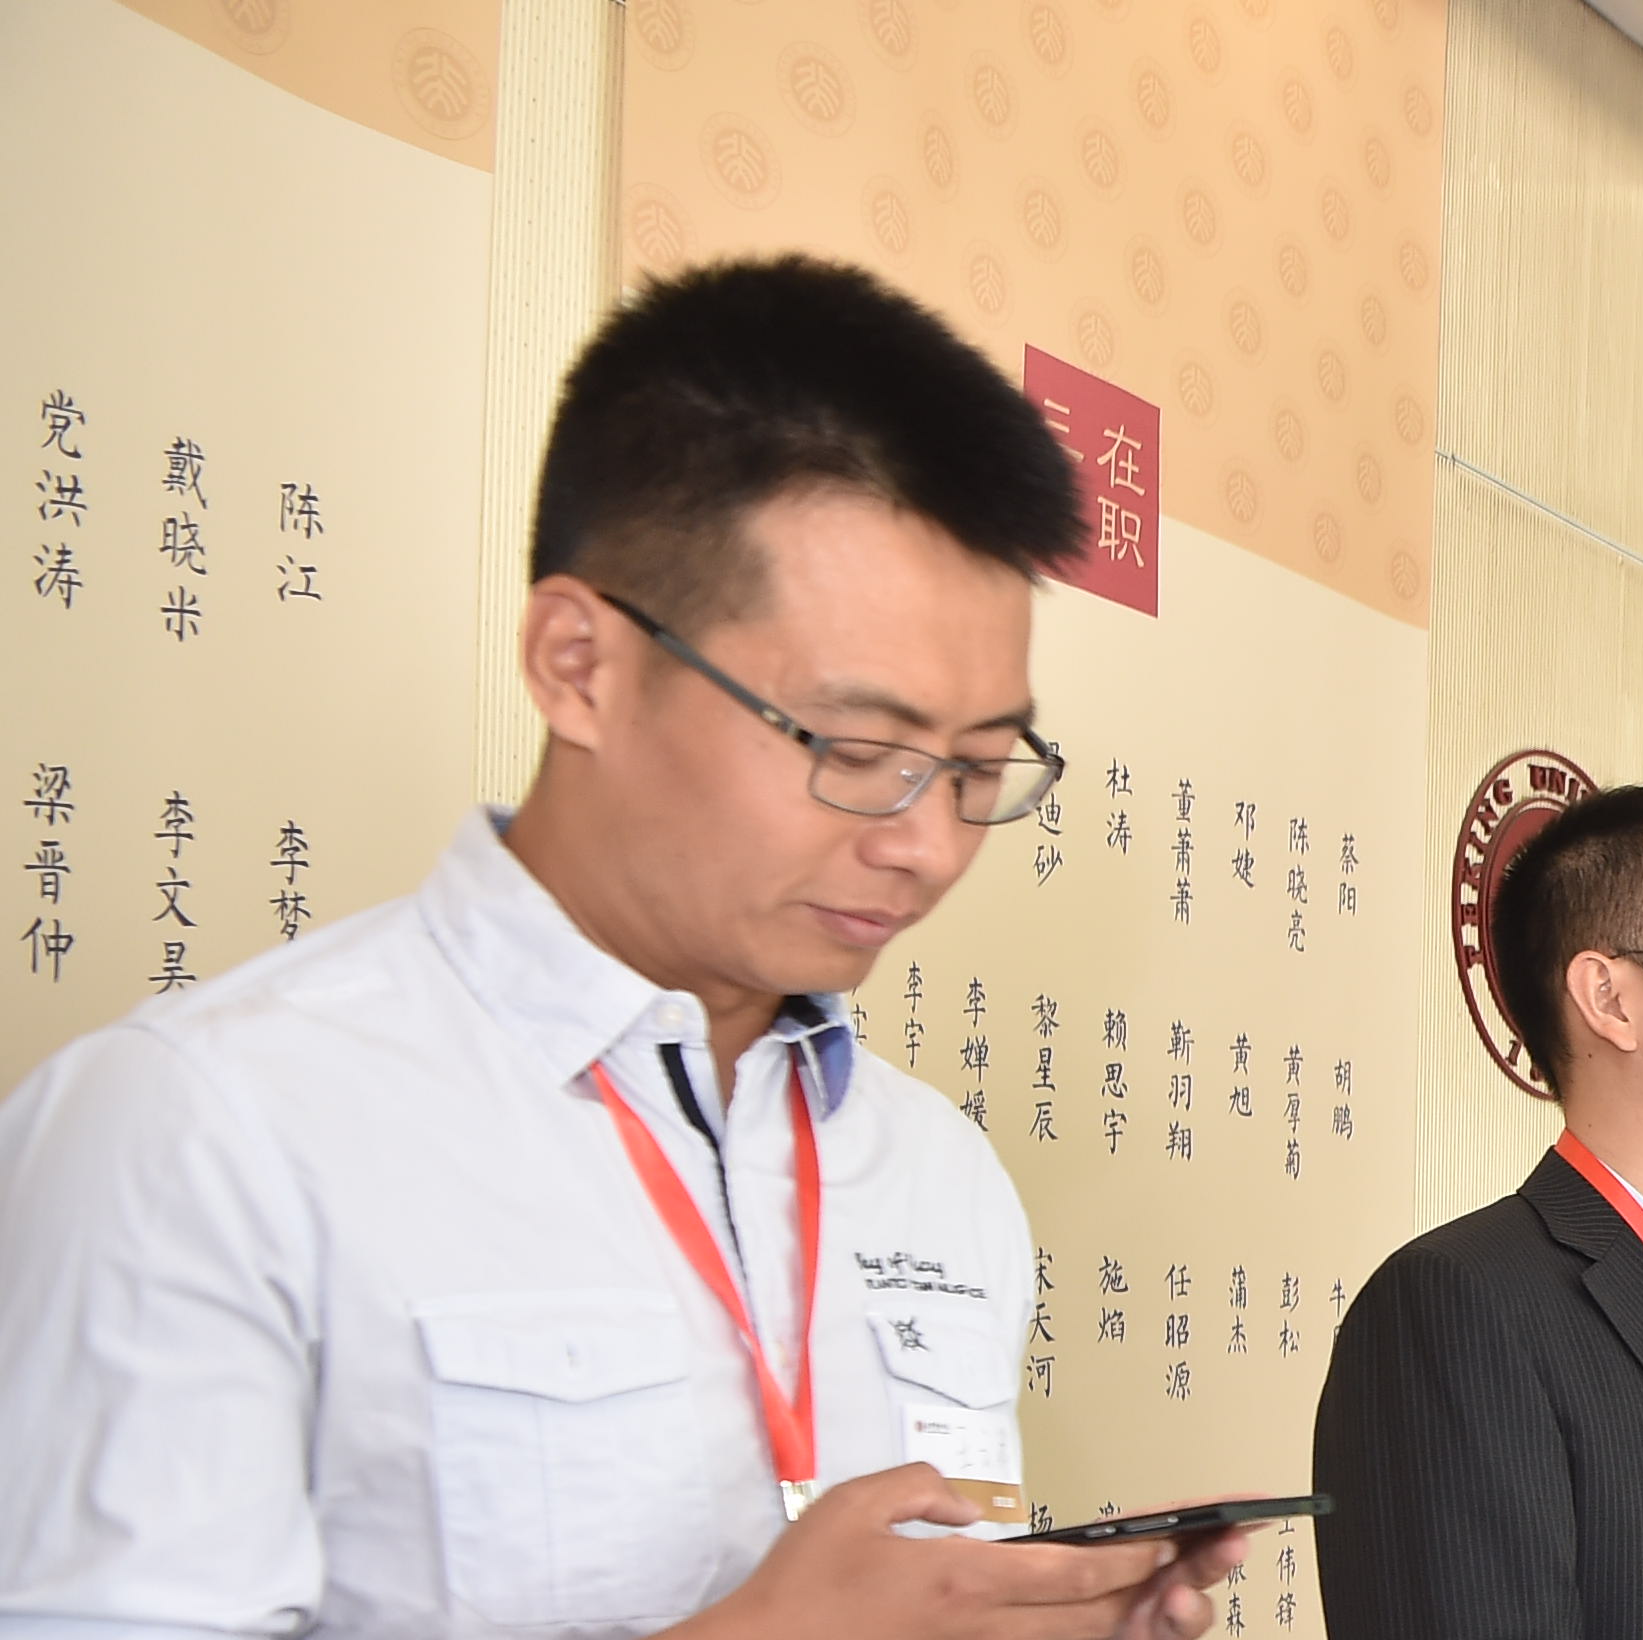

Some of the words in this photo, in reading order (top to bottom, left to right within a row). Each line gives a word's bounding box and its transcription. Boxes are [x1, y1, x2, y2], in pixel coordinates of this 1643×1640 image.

[33, 389, 88, 610] 党洪涛
[276, 483, 324, 601] 陈江
[1097, 424, 1146, 568] 在职
[1032, 741, 1064, 887] 迪砂
[1105, 758, 1133, 855] 杜涛
[1527, 763, 1590, 802] UNI
[269, 820, 311, 941] 李梦
[1286, 817, 1310, 953] 陈晓亮
[1338, 833, 1359, 916] 蔡阳
[903, 961, 925, 1069] 李宇
[1029, 994, 1060, 1142] 黎星辰
[1101, 1008, 1128, 1155] 赖思宇
[1229, 1032, 1253, 1117] 黄旭
[1332, 1059, 1353, 1140] 胡鹏
[1026, 1246, 1056, 1398] 宋天河
[1097, 1255, 1129, 1343] 施焰
[1164, 1263, 1192, 1401] 任昭源
[1227, 1264, 1247, 1354] 蒲杰
[1279, 1271, 1300, 1358] 彭松
[1329, 1278, 1346, 1345] 牛
